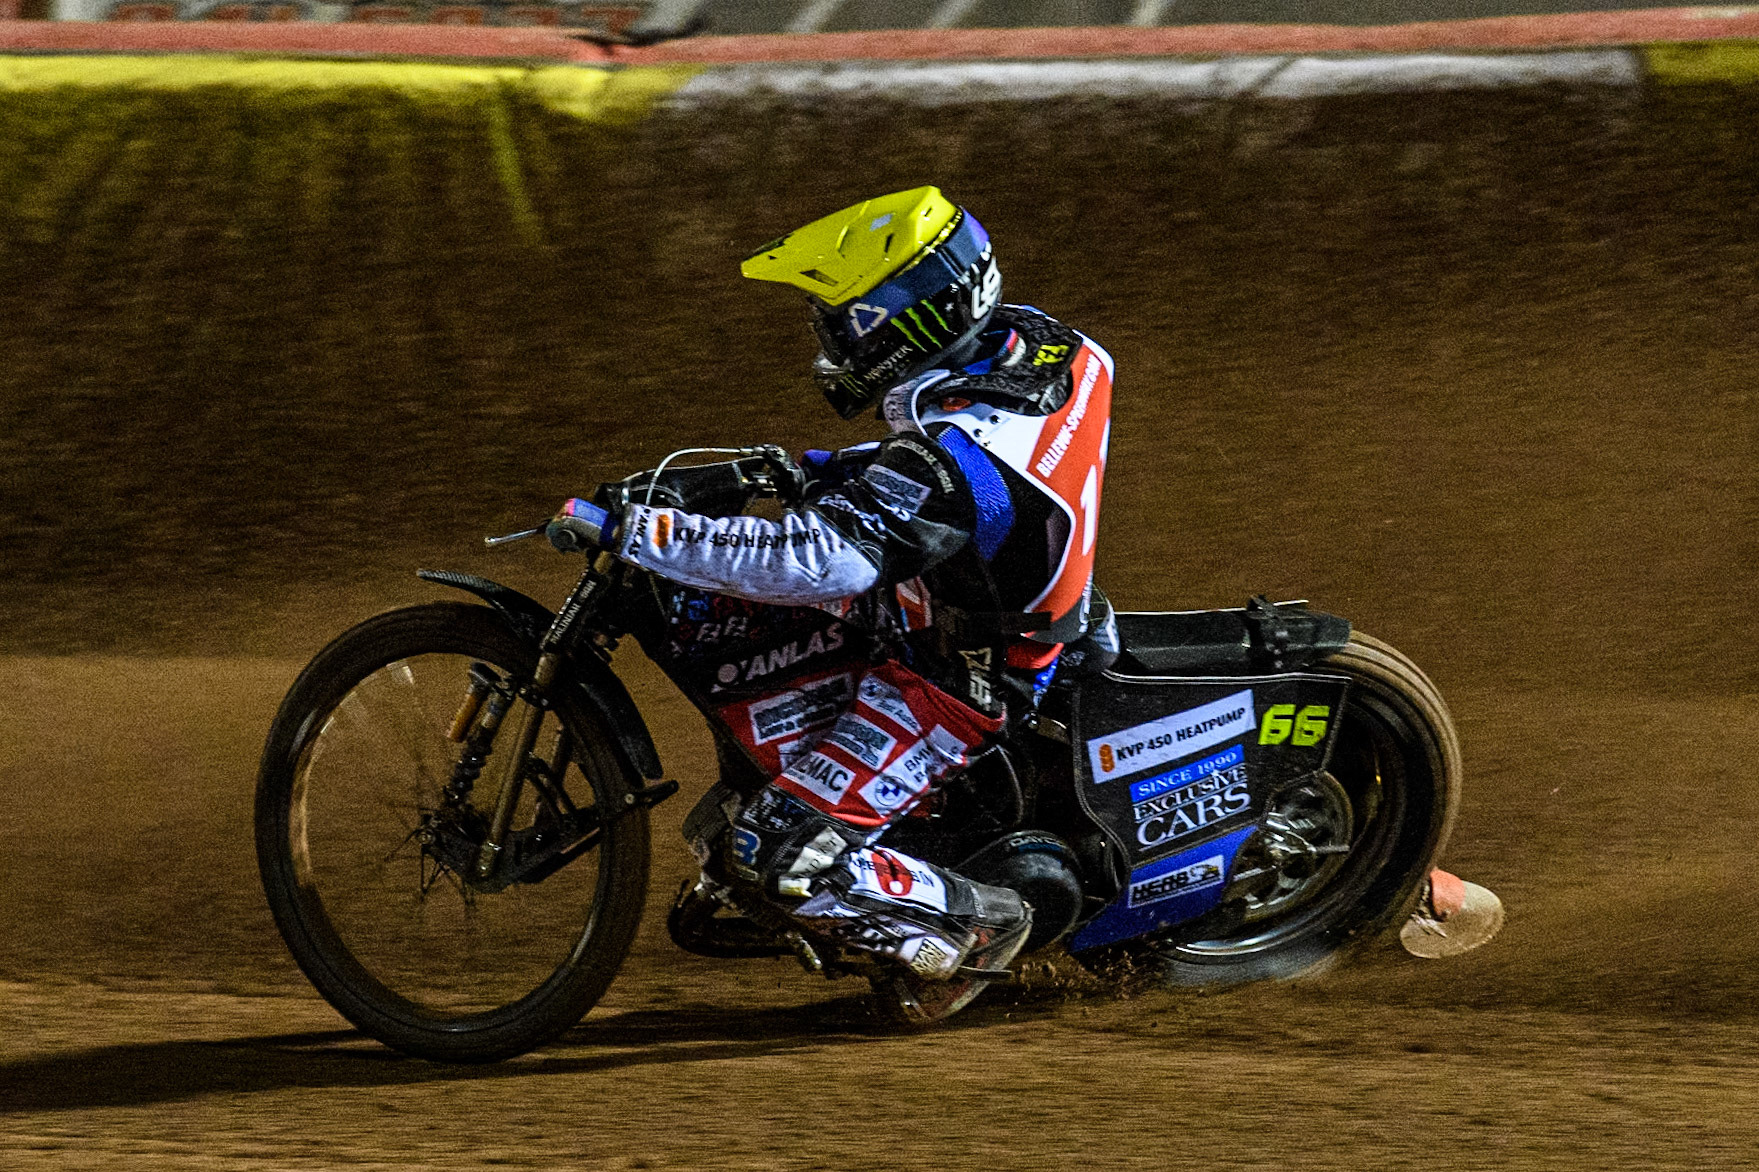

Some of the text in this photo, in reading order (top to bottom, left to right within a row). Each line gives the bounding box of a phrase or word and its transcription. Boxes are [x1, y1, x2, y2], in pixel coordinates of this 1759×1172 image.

[675, 527, 706, 543] KVP
[709, 534, 740, 547] 450
[1080, 464, 1097, 556] 1
[746, 622, 844, 681] ANLAS
[1117, 707, 1246, 761] KVP 450 HEATPUMP
[1258, 704, 1330, 747] 66
[1134, 766, 1247, 821] EXCLUSIVE
[1138, 752, 1238, 797] SINCE 1990
[1137, 784, 1251, 846] CARS
